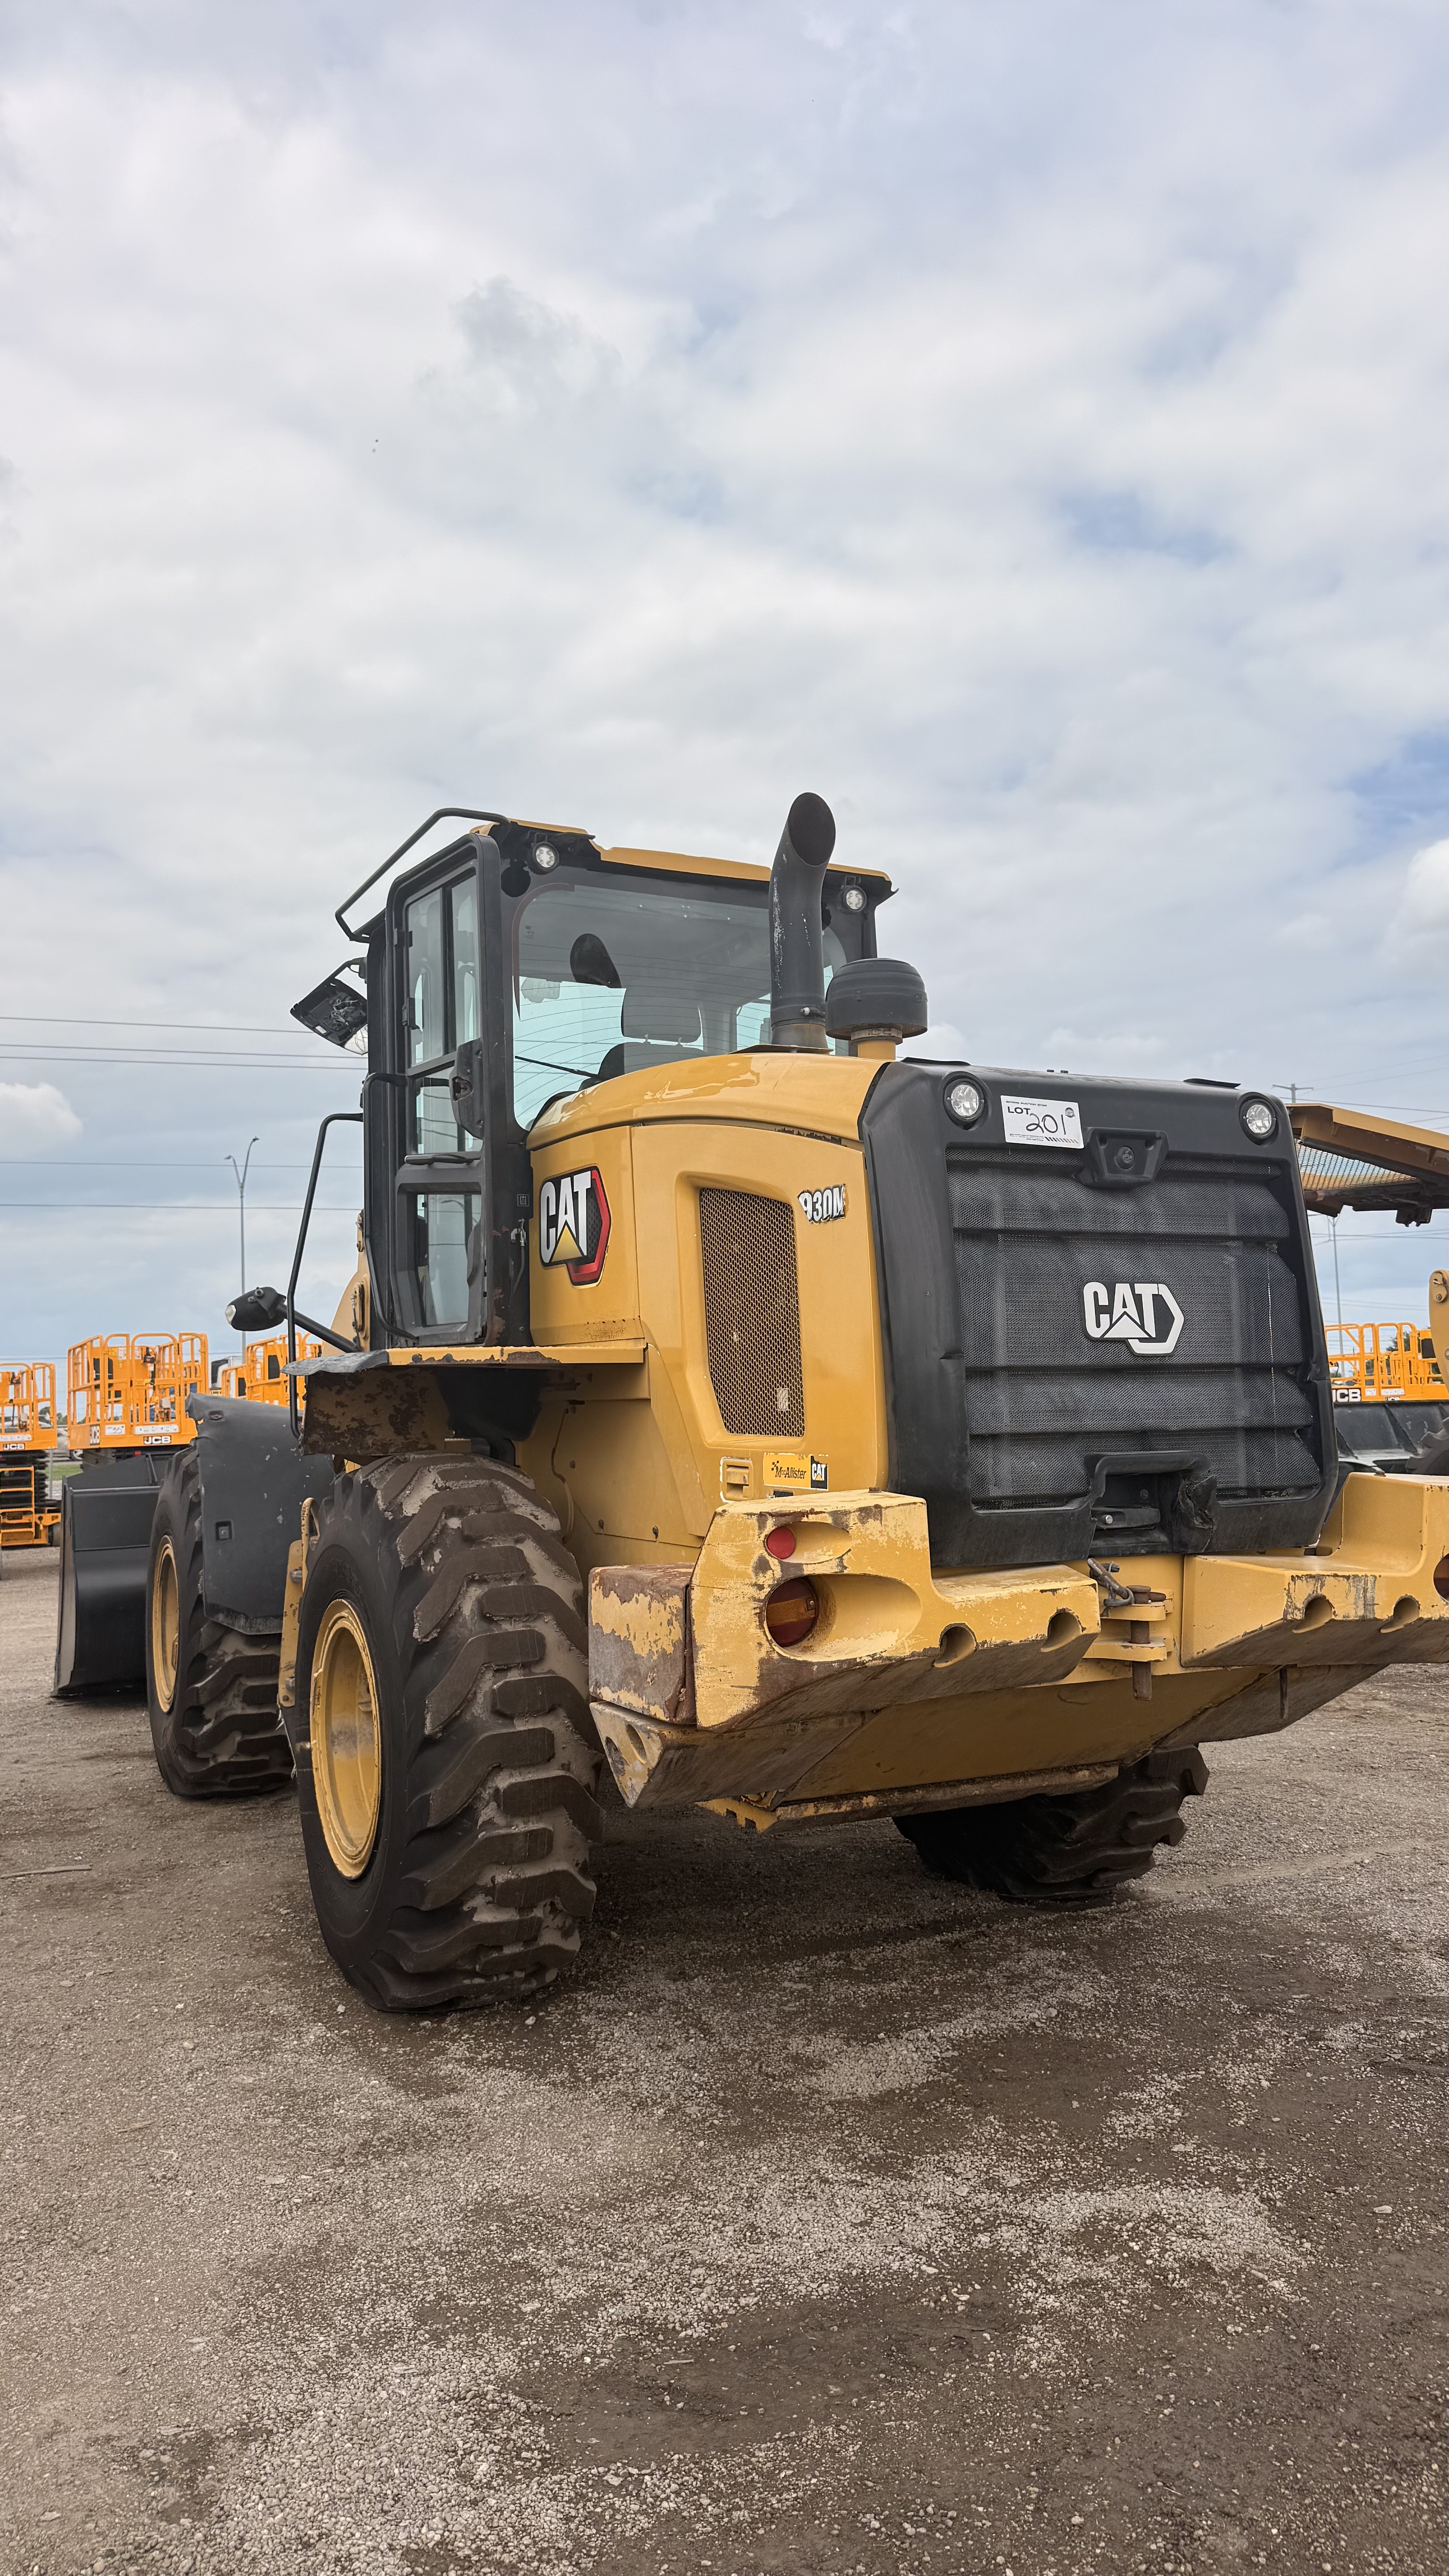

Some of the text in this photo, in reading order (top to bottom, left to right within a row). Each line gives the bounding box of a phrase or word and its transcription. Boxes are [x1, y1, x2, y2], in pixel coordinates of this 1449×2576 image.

[1007, 1106, 1031, 1115] LOT
[1026, 1113, 1066, 1135] 201
[541, 1171, 591, 1263] CAT
[1084, 1282, 1158, 1338] CAT
[144, 1436, 171, 1444] JCB
[775, 1463, 826, 1481] McAllister CAT
